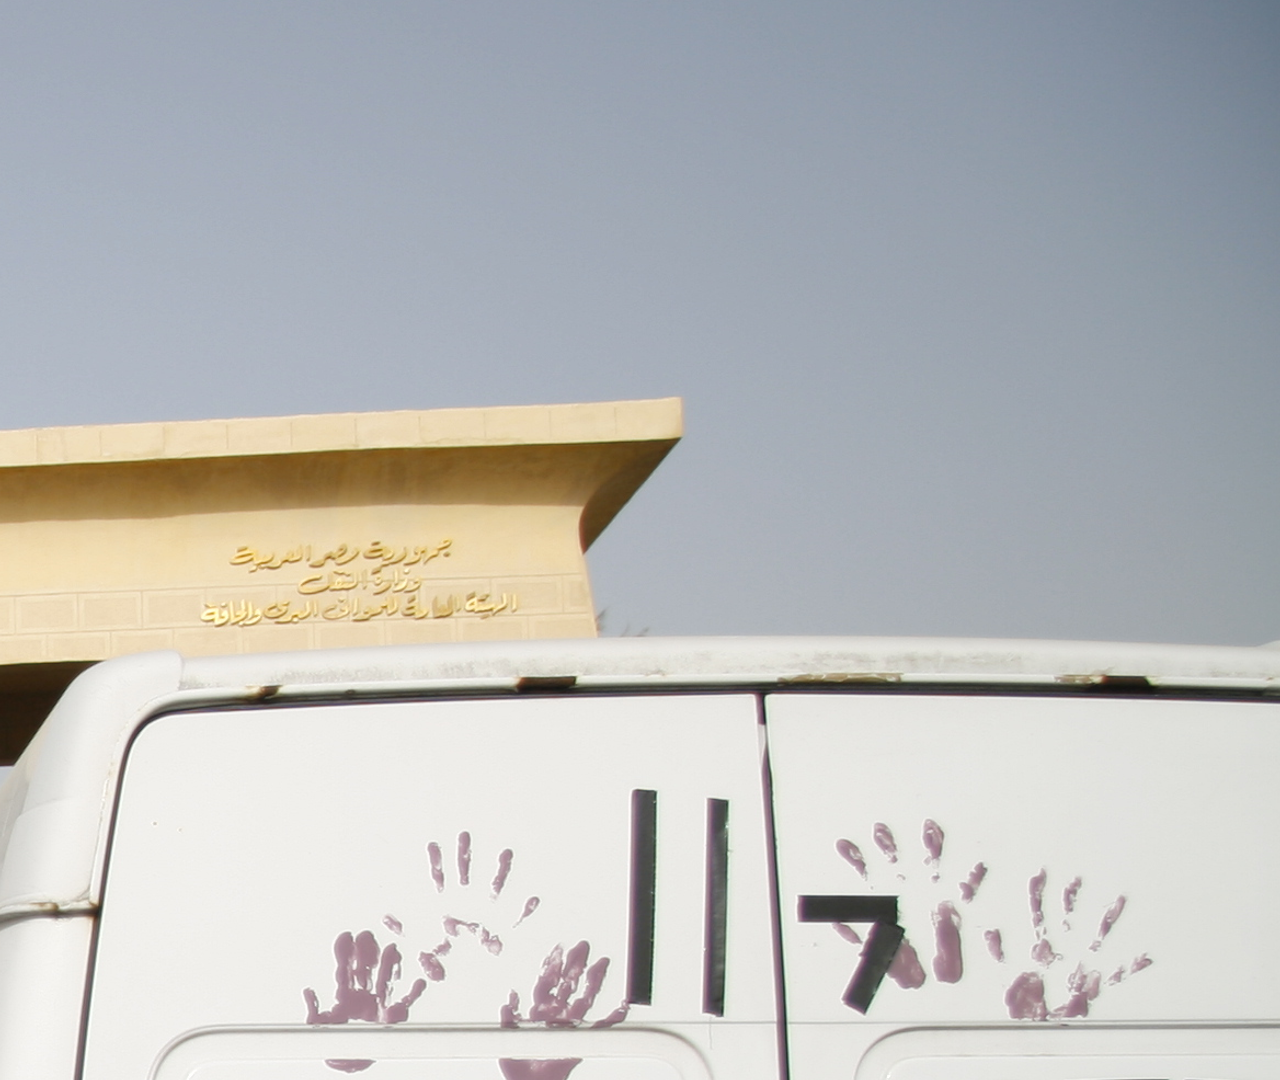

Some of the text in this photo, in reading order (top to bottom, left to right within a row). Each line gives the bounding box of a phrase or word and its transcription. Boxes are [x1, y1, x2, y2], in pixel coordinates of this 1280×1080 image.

[229, 538, 452, 575] جمهورية مصر العربية
[298, 568, 421, 595] وزارة النقل
